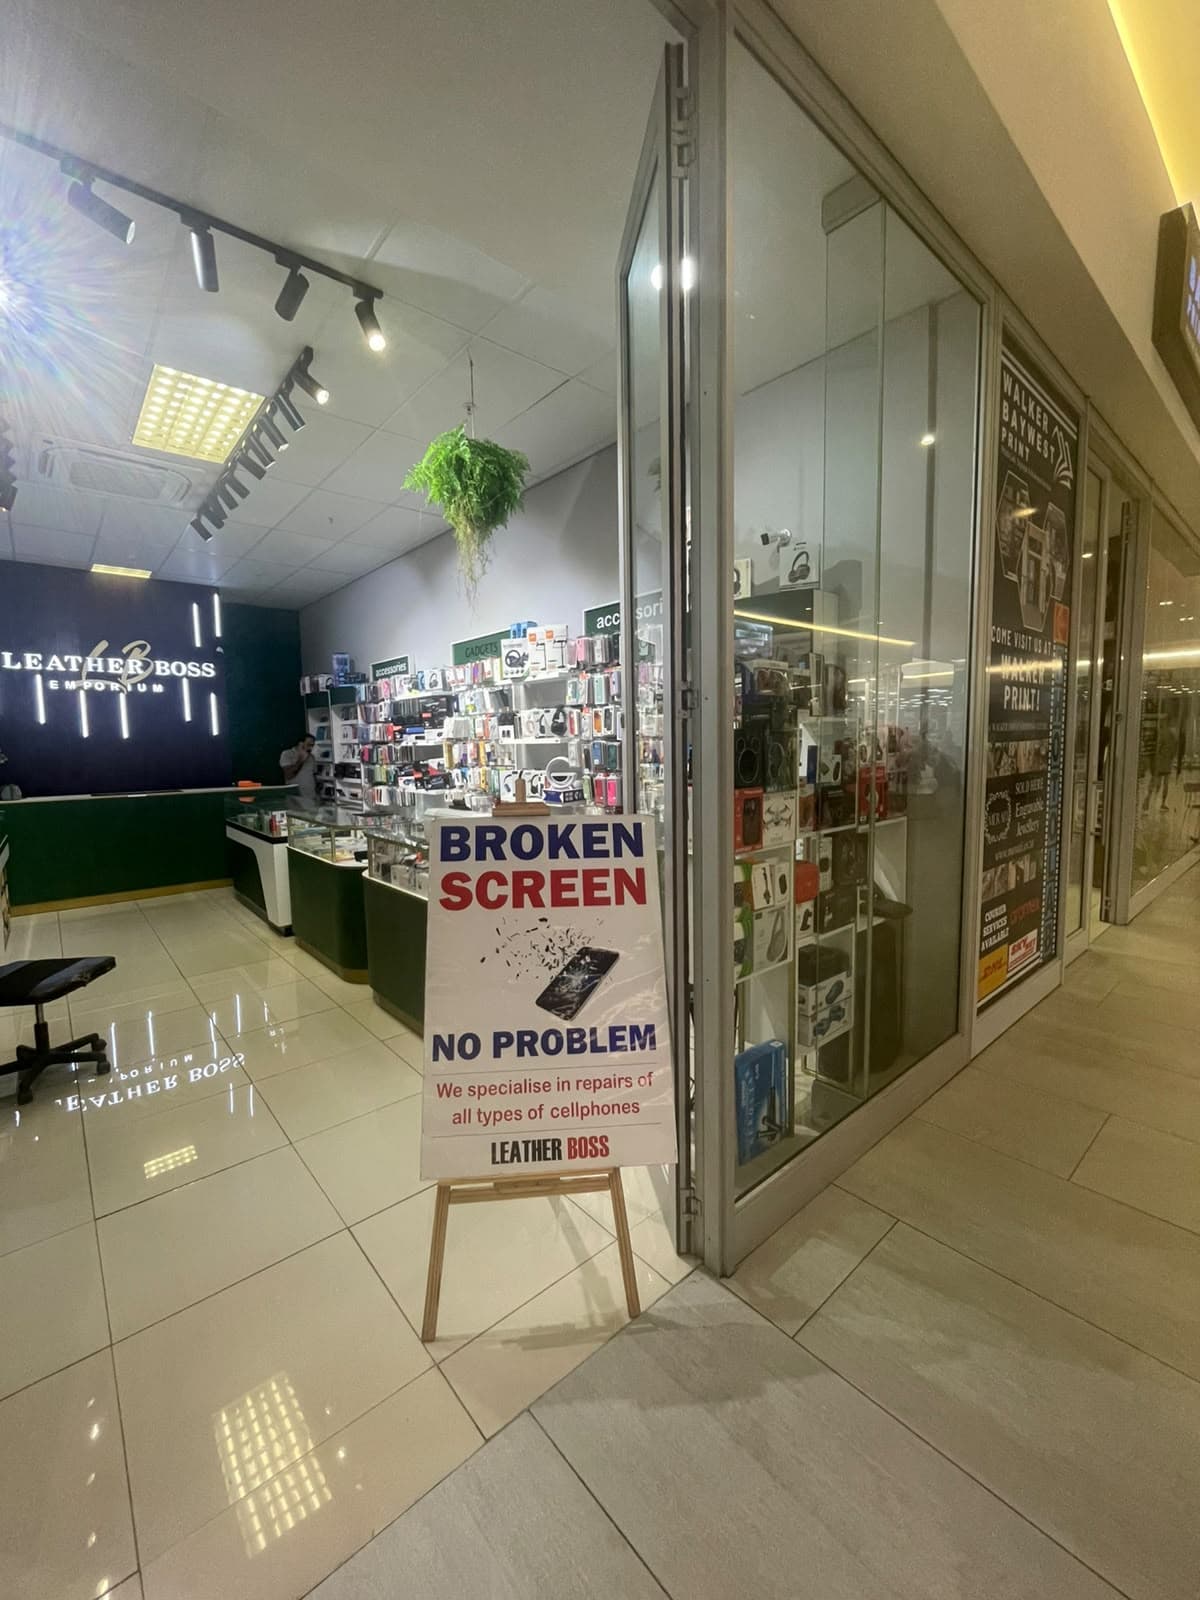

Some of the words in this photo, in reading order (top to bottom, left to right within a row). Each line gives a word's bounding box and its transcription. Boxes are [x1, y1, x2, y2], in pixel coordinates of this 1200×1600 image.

[1002, 369, 1049, 434] WALKER
[1001, 399, 1055, 465] BAYWEST
[1001, 426, 1029, 462] PRINT
[991, 625, 1012, 647] COME
[1014, 631, 1032, 652] VISIT
[1033, 638, 1042, 654] US
[1, 652, 144, 676] LEATHER
[155, 661, 216, 678] BOSS
[375, 661, 408, 678] accessories
[49, 679, 164, 693] EMPORIUM
[1003, 684, 1040, 711] PRINT!
[440, 822, 644, 862] BROKEN
[439, 867, 647, 911] SCREEN
[432, 1033, 482, 1062] NO
[493, 1024, 657, 1059] PROBLEM
[436, 1082, 463, 1099] We
[467, 1079, 552, 1099] specialise
[556, 1076, 571, 1093] in
[575, 1073, 633, 1096] repairs
[637, 1071, 654, 1088] of
[452, 1108, 472, 1125] all
[477, 1107, 523, 1127] types
[528, 1104, 544, 1121] of
[550, 1100, 640, 1122] cellphones
[491, 1138, 563, 1165] LEATHER
[567, 1135, 610, 1160] BOSS
